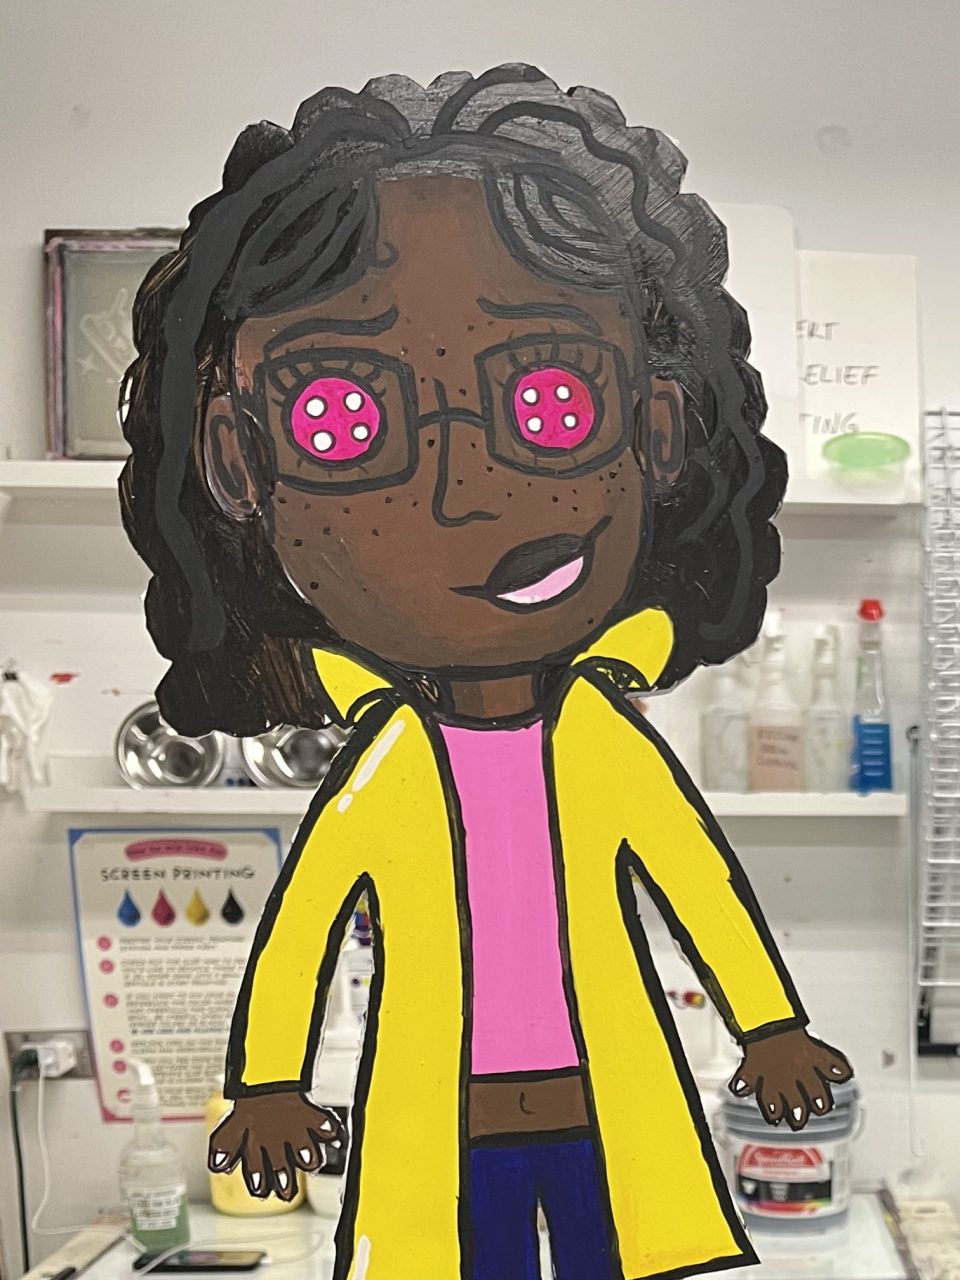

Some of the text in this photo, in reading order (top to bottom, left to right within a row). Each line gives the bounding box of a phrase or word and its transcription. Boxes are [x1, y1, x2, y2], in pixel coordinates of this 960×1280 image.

[798, 364, 880, 385] ELIEF
[101, 864, 255, 881] SCREEN PRINTING
